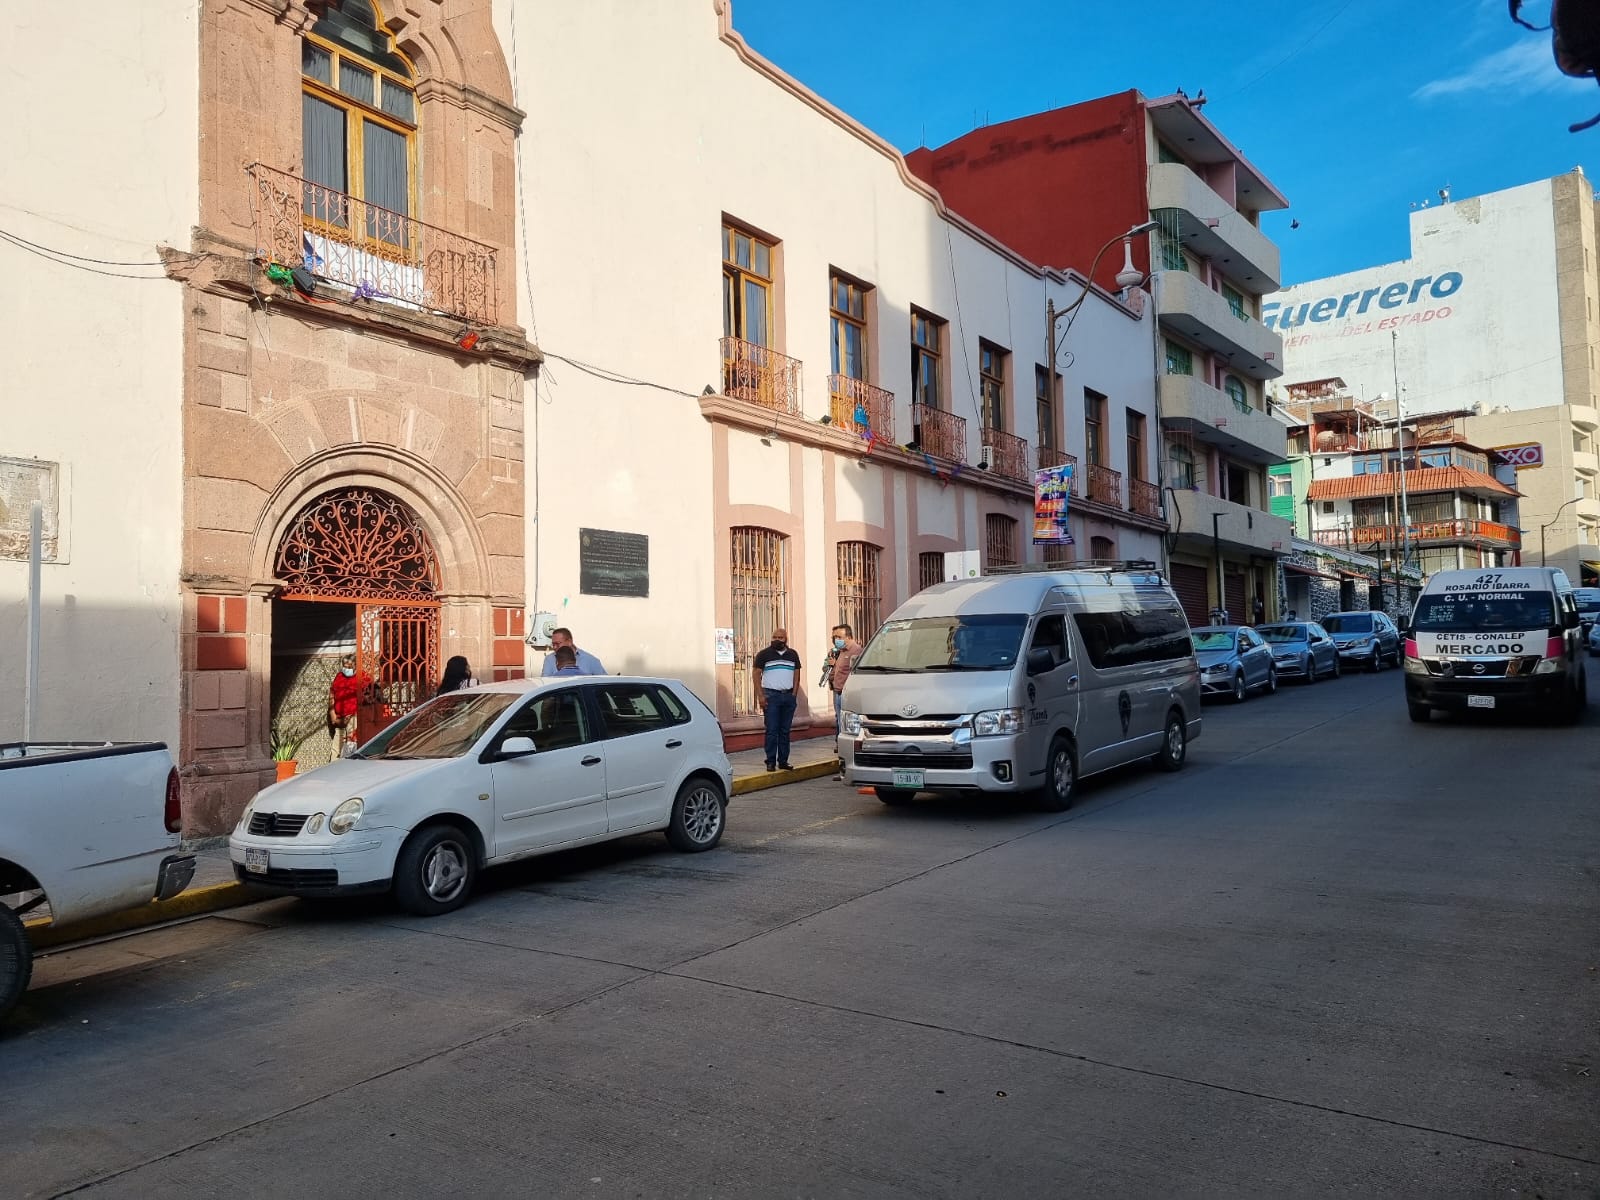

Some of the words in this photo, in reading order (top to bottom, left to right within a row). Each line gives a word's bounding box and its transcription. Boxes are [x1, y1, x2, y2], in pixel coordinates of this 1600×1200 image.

[1262, 271, 1463, 330] Guerrero
[1378, 306, 1453, 331] ESTADO
[1498, 446, 1539, 464] XXO
[1475, 574, 1503, 584] 427
[1445, 584, 1490, 592] ROSARIO
[1492, 582, 1530, 590] IBARRA
[1478, 593, 1525, 601] NORMAL
[1436, 633, 1466, 641] CETIS
[1475, 632, 1525, 640] CONALEP
[1435, 643, 1524, 655] MERCADO
